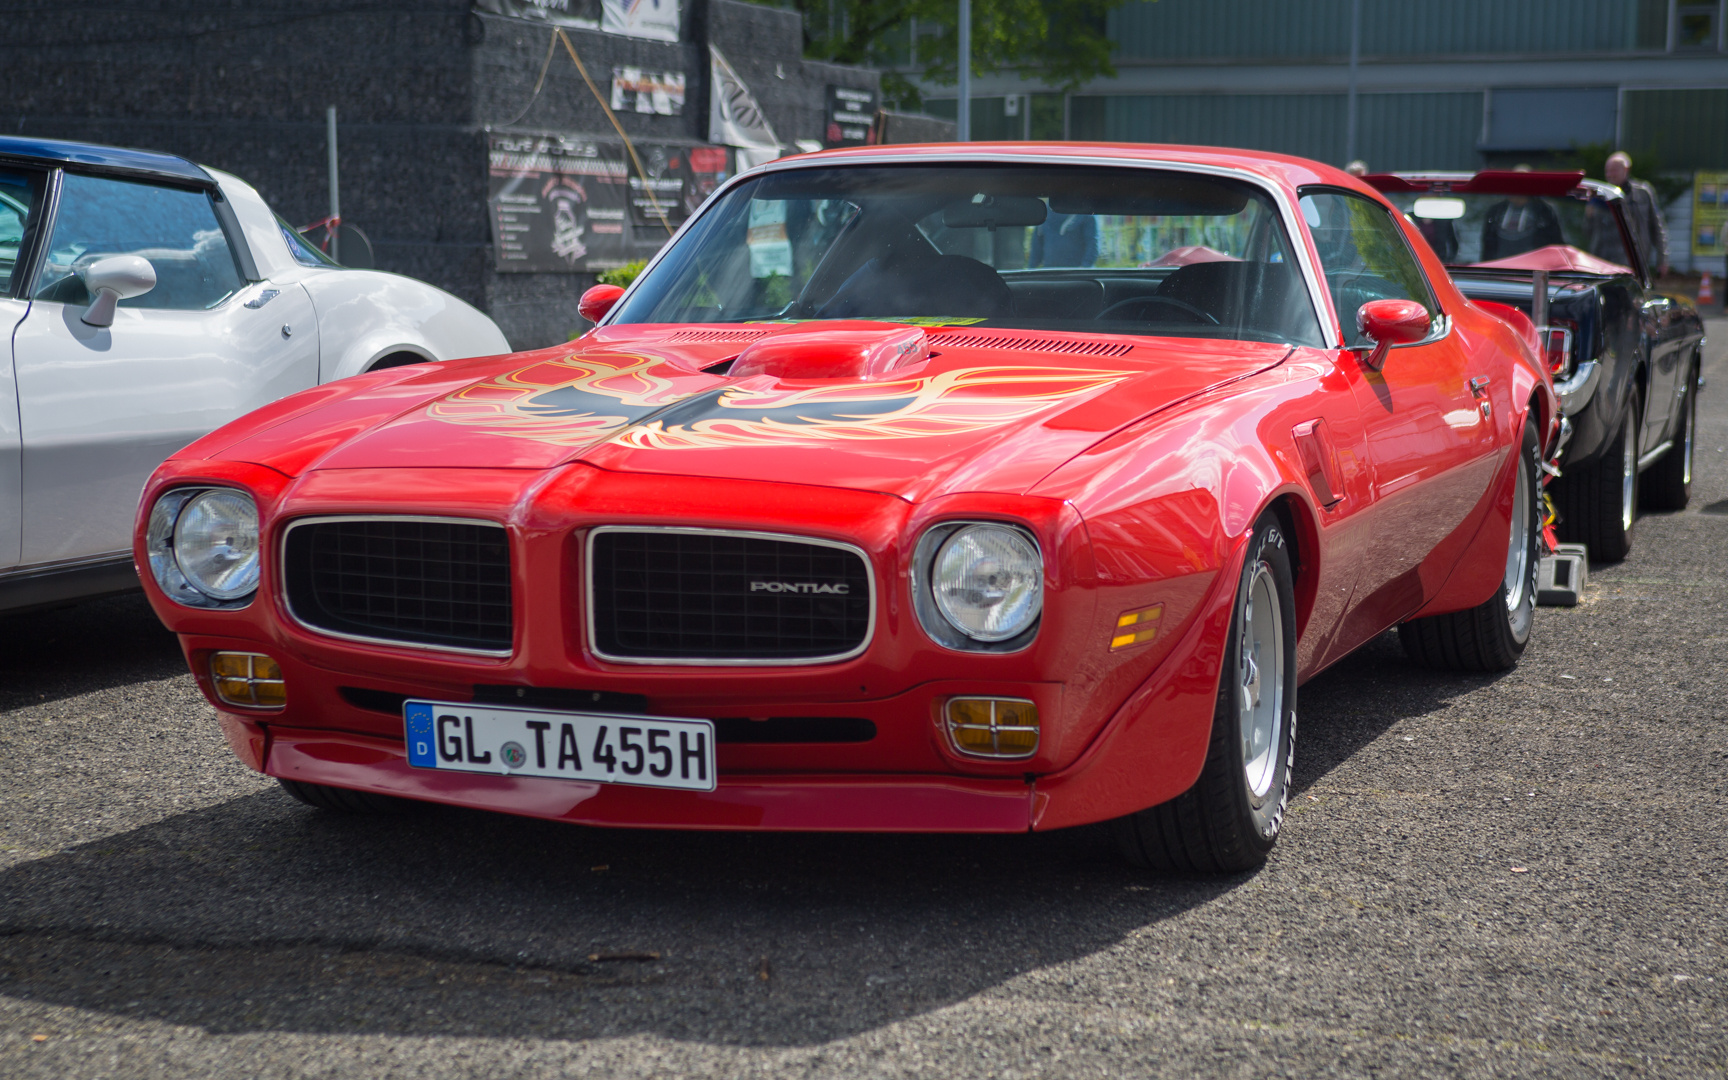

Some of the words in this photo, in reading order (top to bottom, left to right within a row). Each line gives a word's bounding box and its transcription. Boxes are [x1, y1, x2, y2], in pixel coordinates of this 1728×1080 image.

[897, 340, 917, 356] 455
[1532, 444, 1543, 551] RADIAL
[1267, 528, 1285, 550] G/T
[750, 581, 850, 595] PONTIAC
[416, 741, 428, 755] D
[437, 714, 492, 765] GL
[526, 720, 582, 772] TA
[593, 725, 707, 781] 455H
